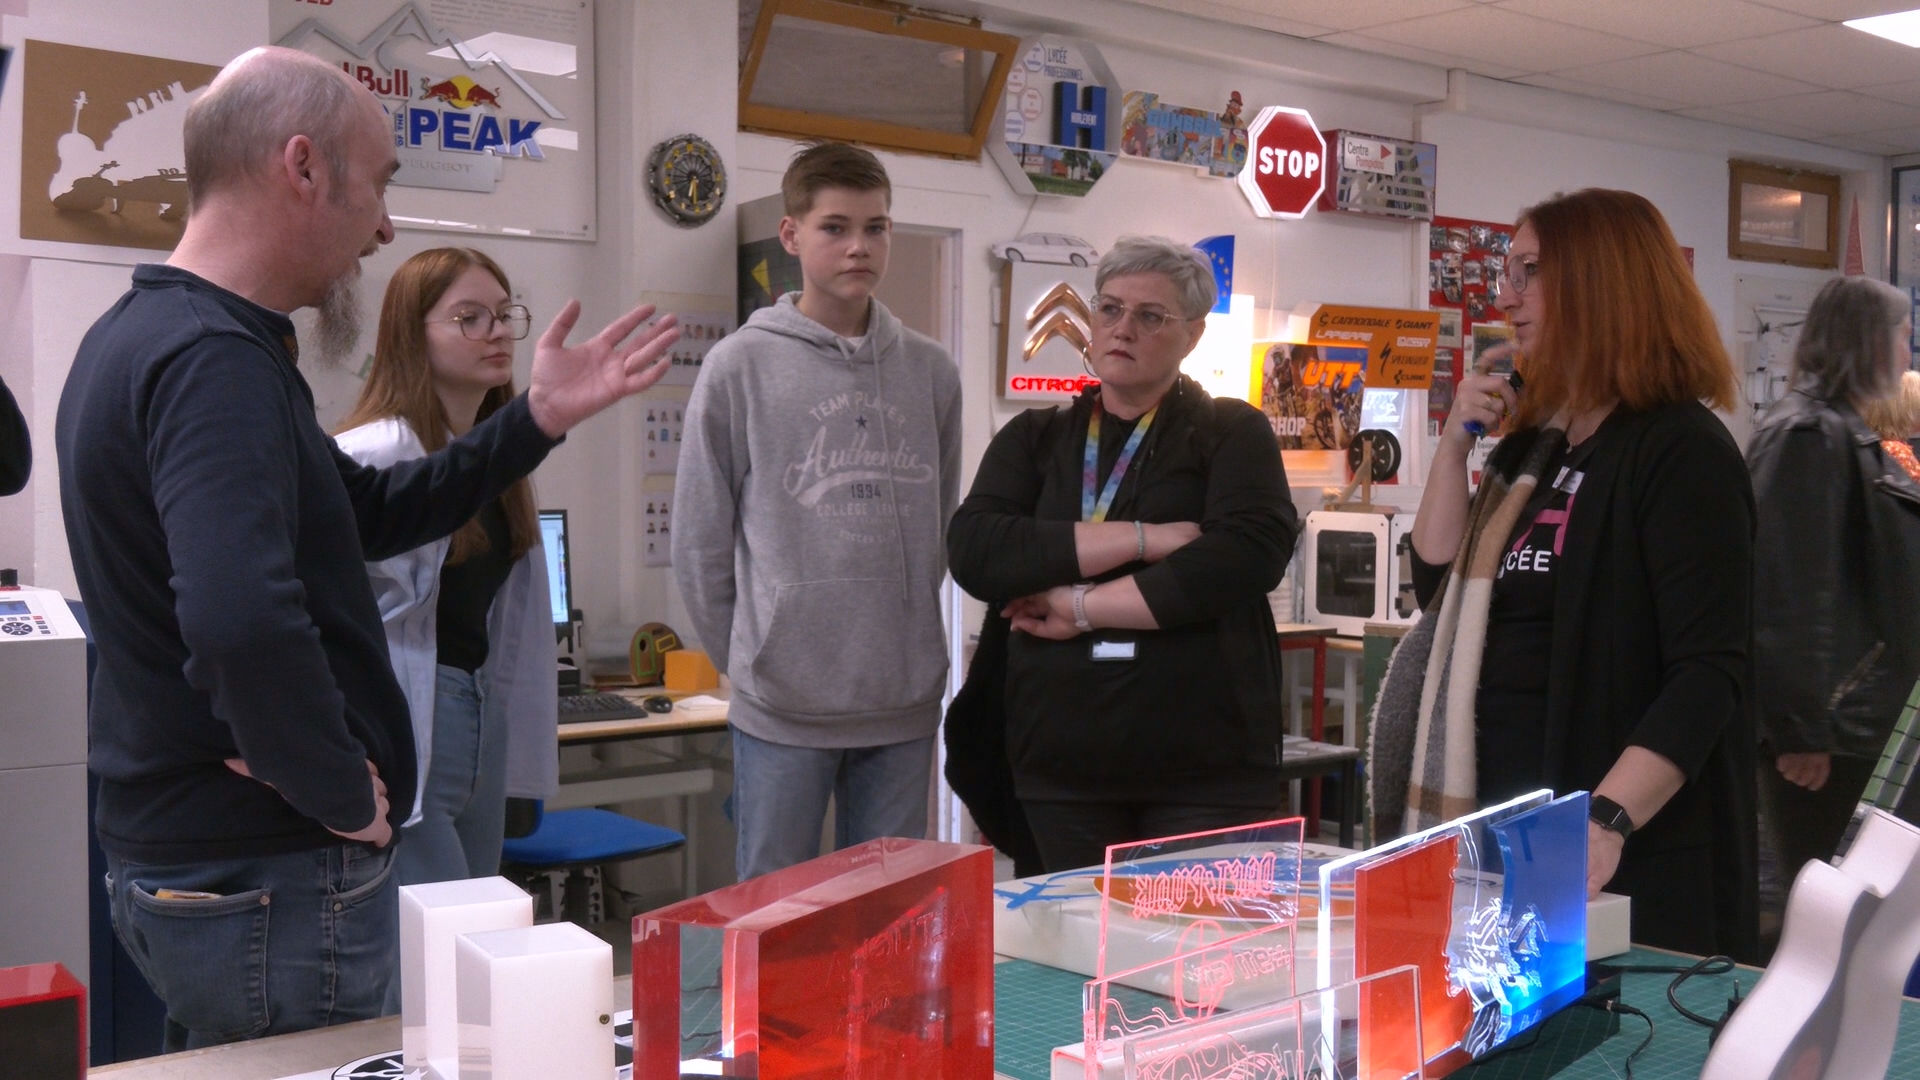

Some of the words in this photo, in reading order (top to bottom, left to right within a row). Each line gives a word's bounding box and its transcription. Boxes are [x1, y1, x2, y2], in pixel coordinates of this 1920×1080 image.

[1048, 47, 1068, 64] LYCÉE
[356, 65, 409, 97] Bull
[1053, 81, 1107, 152] H
[410, 107, 545, 159] PEAK
[1258, 145, 1320, 179] STOP
[1347, 141, 1369, 157] Centre
[1355, 156, 1385, 170] Pompidou
[1331, 315, 1392, 328] CANNONDALE
[1402, 320, 1434, 330] GIANT
[1302, 360, 1362, 388] UTT
[809, 393, 851, 422] TEAM
[783, 425, 932, 497] Authentic
[816, 502, 868, 518] COLLEGE
[1497, 545, 1552, 573] YCÉE
